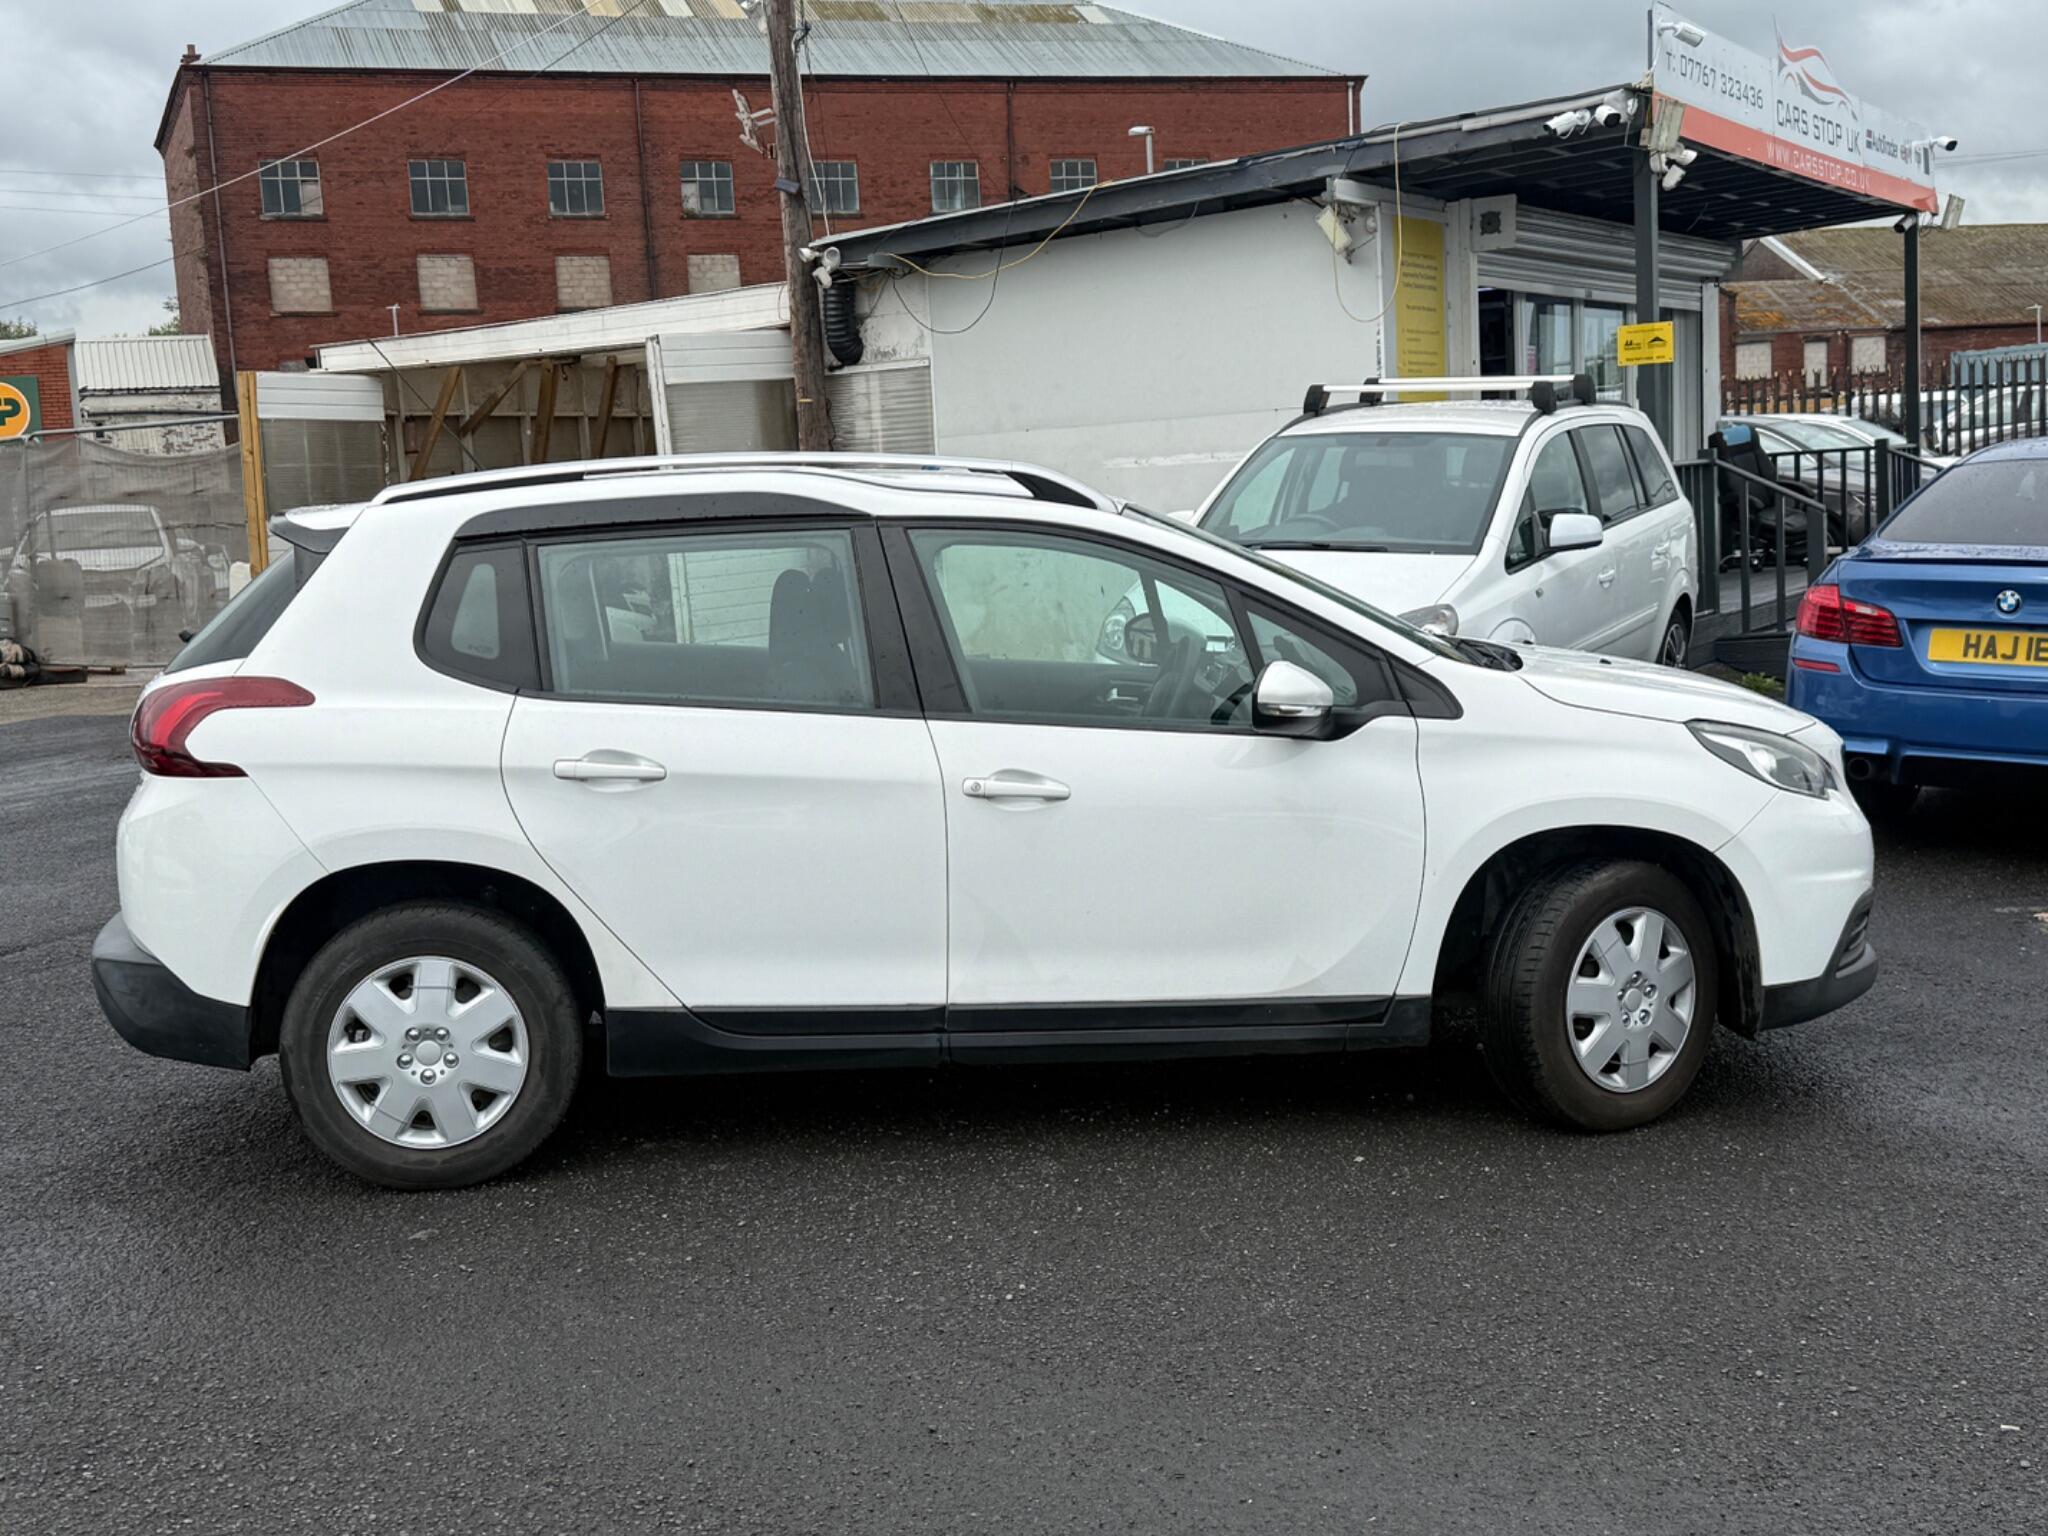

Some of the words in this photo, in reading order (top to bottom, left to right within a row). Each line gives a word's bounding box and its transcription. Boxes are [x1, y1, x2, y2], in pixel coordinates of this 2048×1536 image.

[1680, 53, 1717, 90] 07767
[1720, 73, 1763, 109] 323436
[1776, 99, 1809, 136] CARS
[1813, 114, 1842, 148] STOP
[1846, 127, 1861, 156] UK
